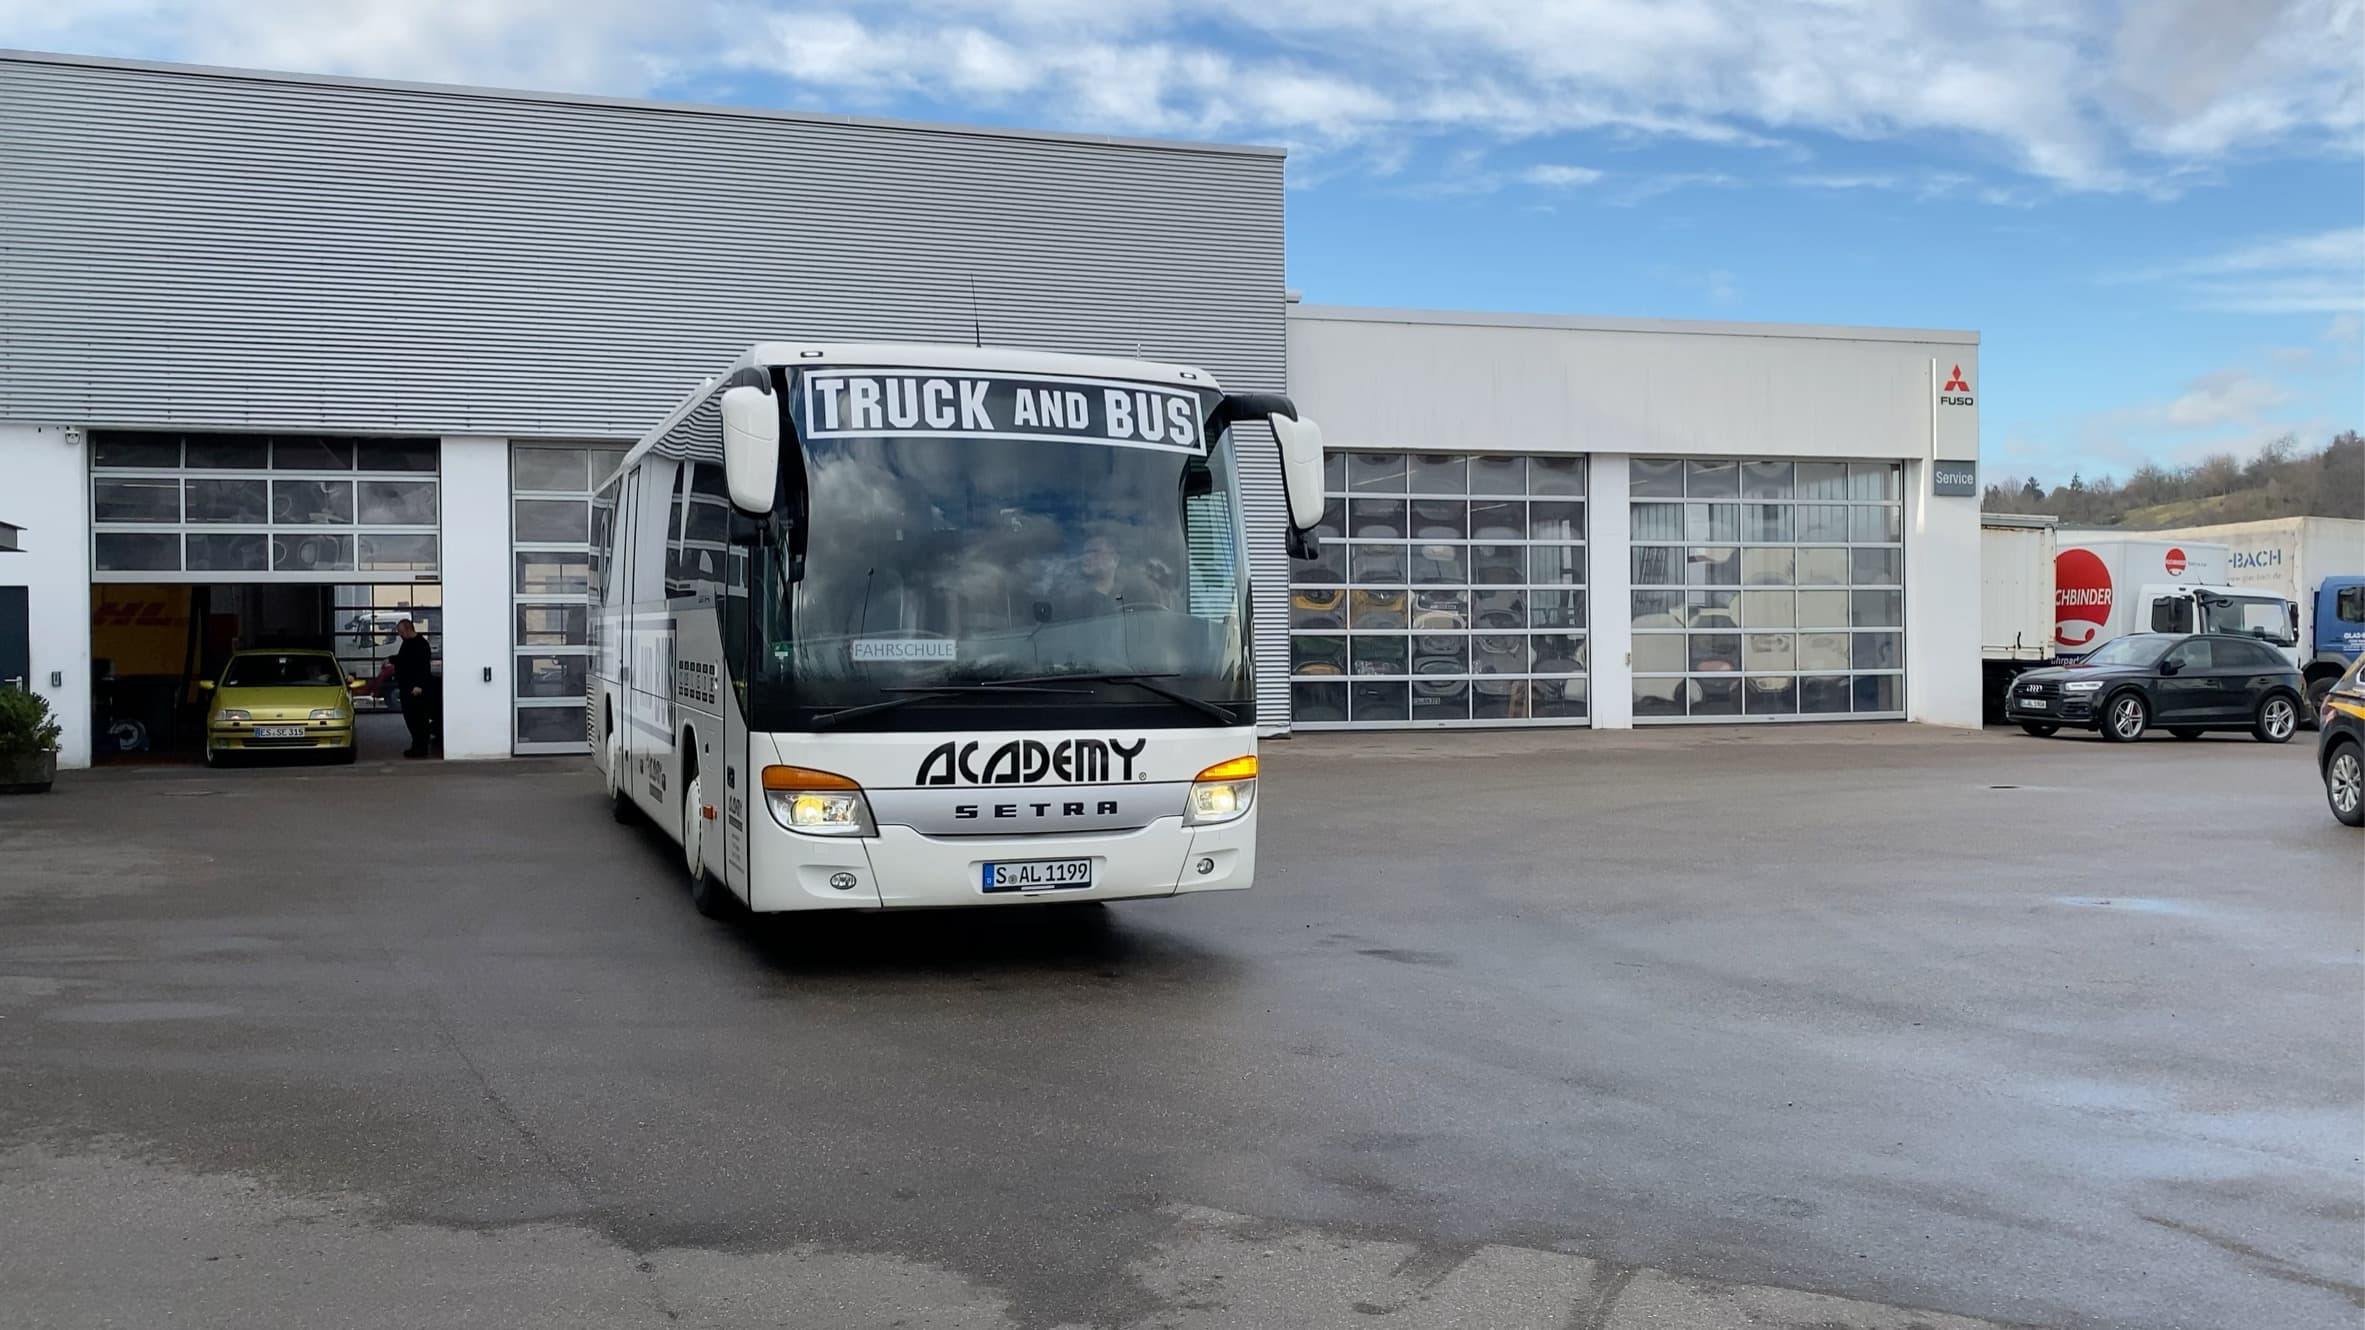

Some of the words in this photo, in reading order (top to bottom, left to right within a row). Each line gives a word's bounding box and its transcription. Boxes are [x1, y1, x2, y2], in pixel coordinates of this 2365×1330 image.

[1941, 396, 1974, 406] FUSO
[815, 377, 995, 431] TRUCK
[1014, 388, 1090, 430] AND
[1104, 388, 1195, 446] BUS
[1936, 471, 1974, 485] Service
[2056, 588, 2112, 606] CHBINDER
[854, 643, 953, 657] FAHRSCHULE
[261, 728, 271, 737] ES
[915, 738, 1147, 786] ACADEMY
[955, 801, 1118, 819] SETRA
[996, 867, 1007, 884] S
[1020, 865, 1041, 883] AL
[1046, 863, 1088, 882] 1199
